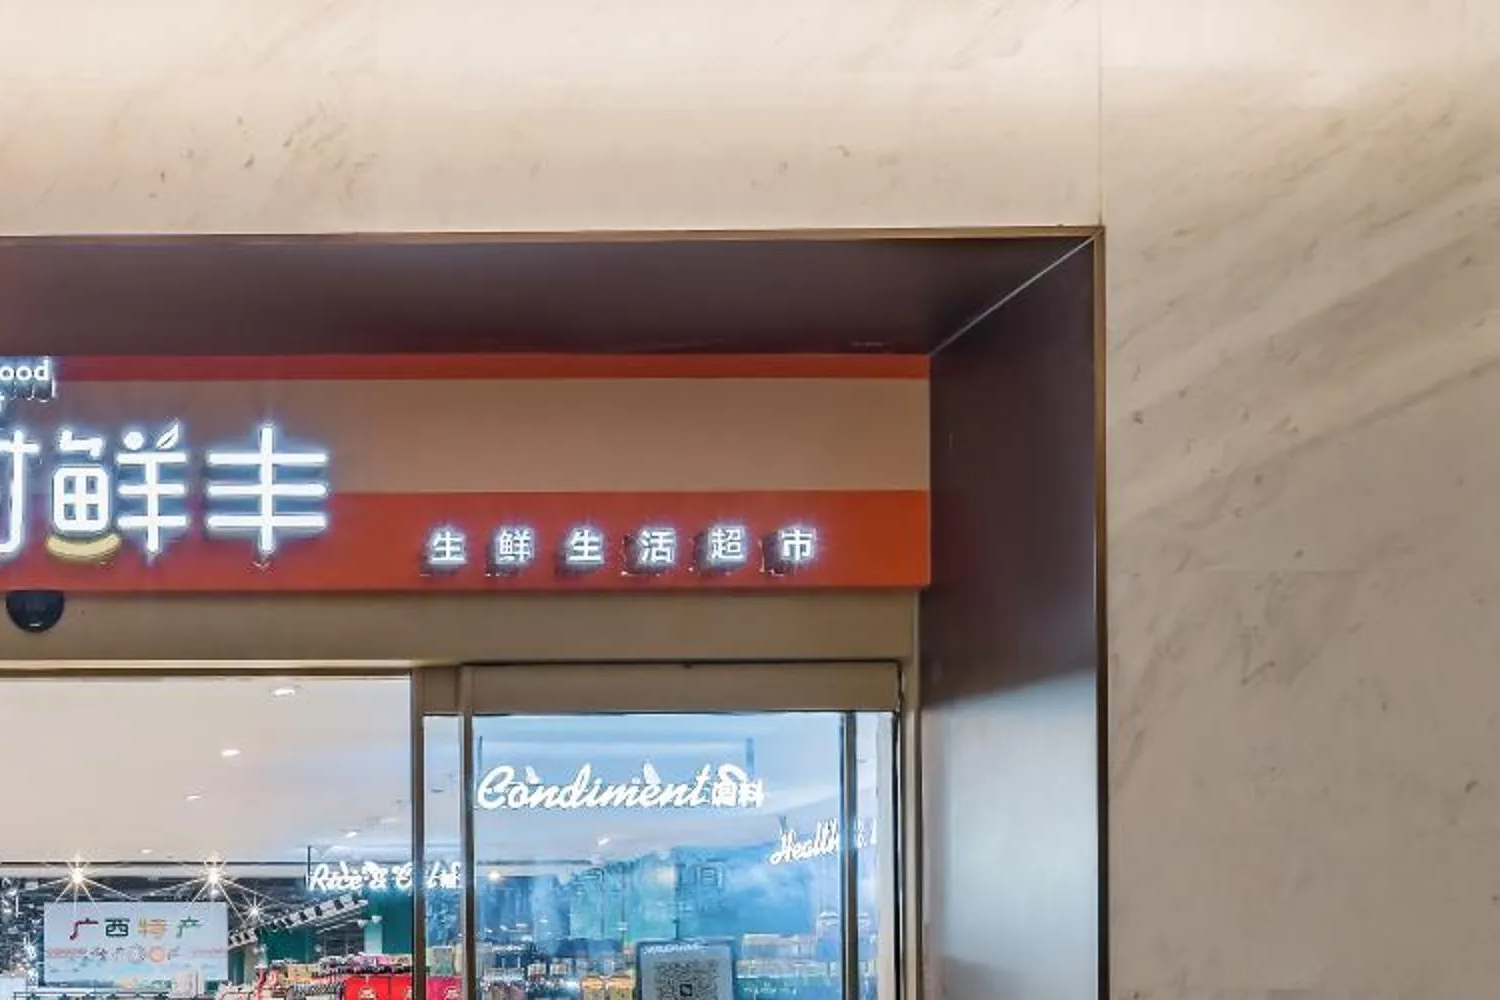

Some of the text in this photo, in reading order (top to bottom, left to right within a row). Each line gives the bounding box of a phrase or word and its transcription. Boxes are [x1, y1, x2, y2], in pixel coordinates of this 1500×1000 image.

[430, 527, 817, 564] 生鲜生活超市
[477, 762, 711, 808] Condiment
[69, 916, 200, 940] 广西特产
